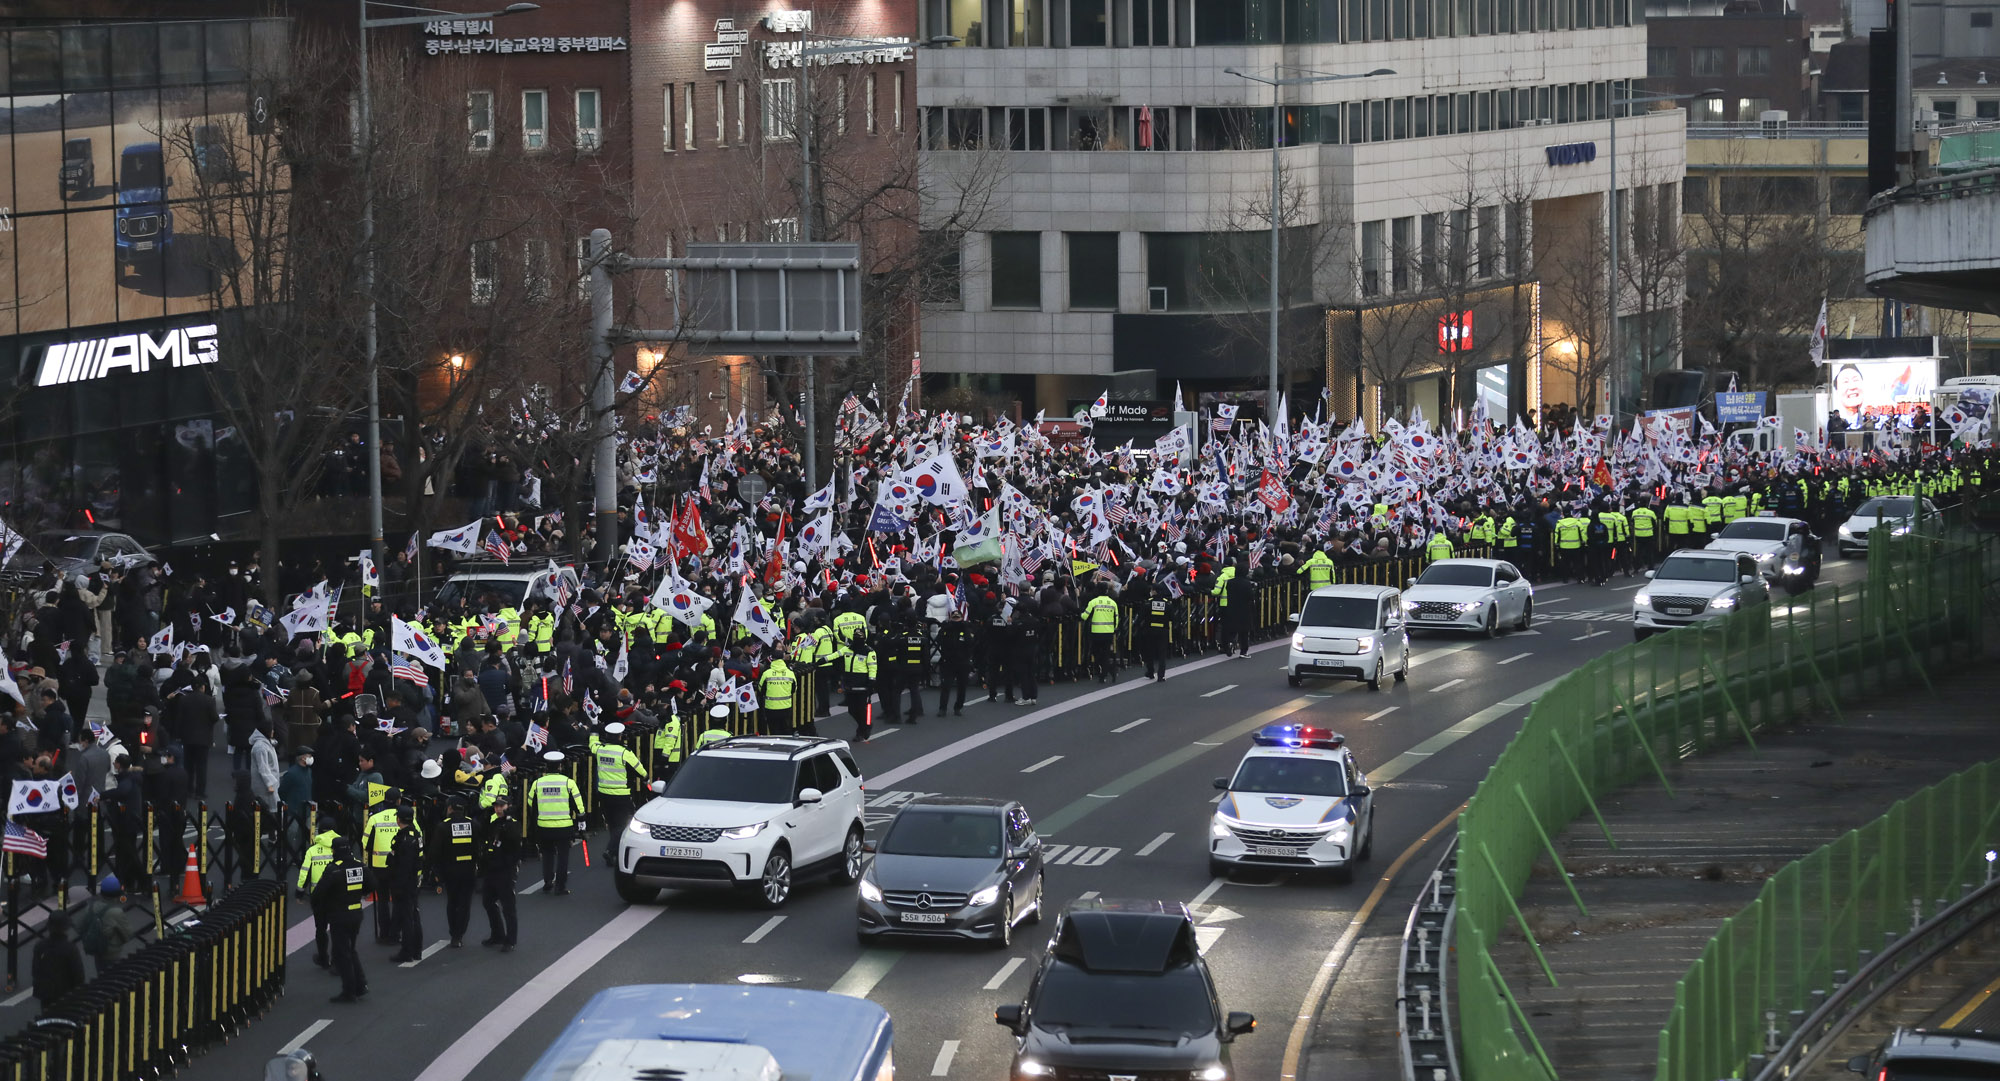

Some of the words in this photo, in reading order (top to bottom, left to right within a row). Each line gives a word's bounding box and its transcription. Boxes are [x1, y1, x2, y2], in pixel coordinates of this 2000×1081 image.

[424, 20, 494, 35] 서울특별시
[557, 36, 627, 51] 중부캠퍼스
[1119, 405, 1148, 415] Made
[683, 848, 700, 857] 3116
[921, 914, 942, 922] 7506
